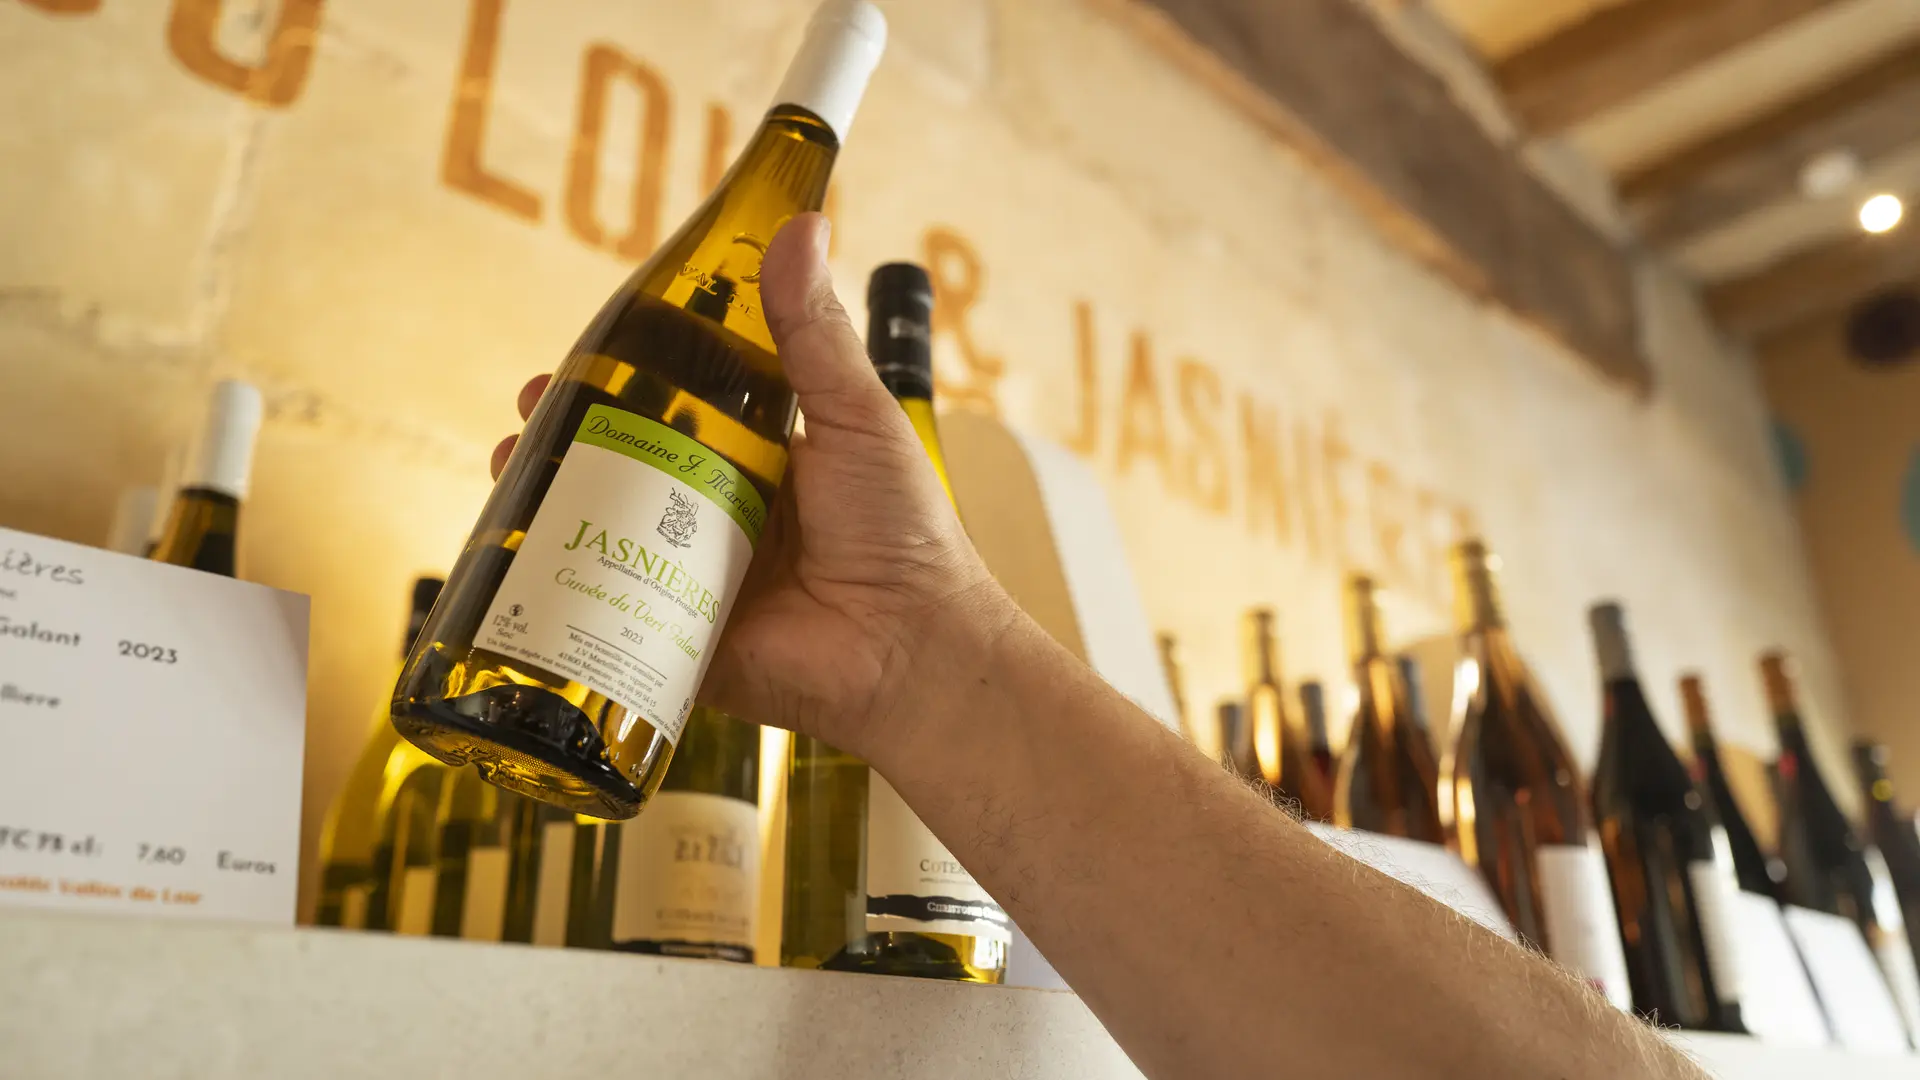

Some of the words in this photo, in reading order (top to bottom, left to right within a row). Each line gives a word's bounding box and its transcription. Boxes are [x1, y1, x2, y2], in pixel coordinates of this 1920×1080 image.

[440, 0, 840, 264] LOI
[920, 225, 1006, 416] &
[587, 415, 679, 462] Domaine
[678, 454, 706, 475] J.
[0, 548, 84, 585] ières
[564, 519, 720, 624] JASNIÈRES
[597, 555, 643, 582] Appellation
[643, 577, 675, 603] d'Origine
[675, 596, 699, 619] Protégée
[555, 566, 607, 601] Cuvée
[608, 593, 631, 613] du
[632, 599, 668, 633] Vert
[669, 623, 702, 661] Galant
[496, 628, 515, 640] Sec
[512, 622, 529, 635] vol.
[569, 631, 584, 644] Mis
[620, 626, 645, 646] 2023
[117, 638, 179, 665] 2023
[558, 651, 582, 666] 41800
[216, 850, 277, 875] Euros
